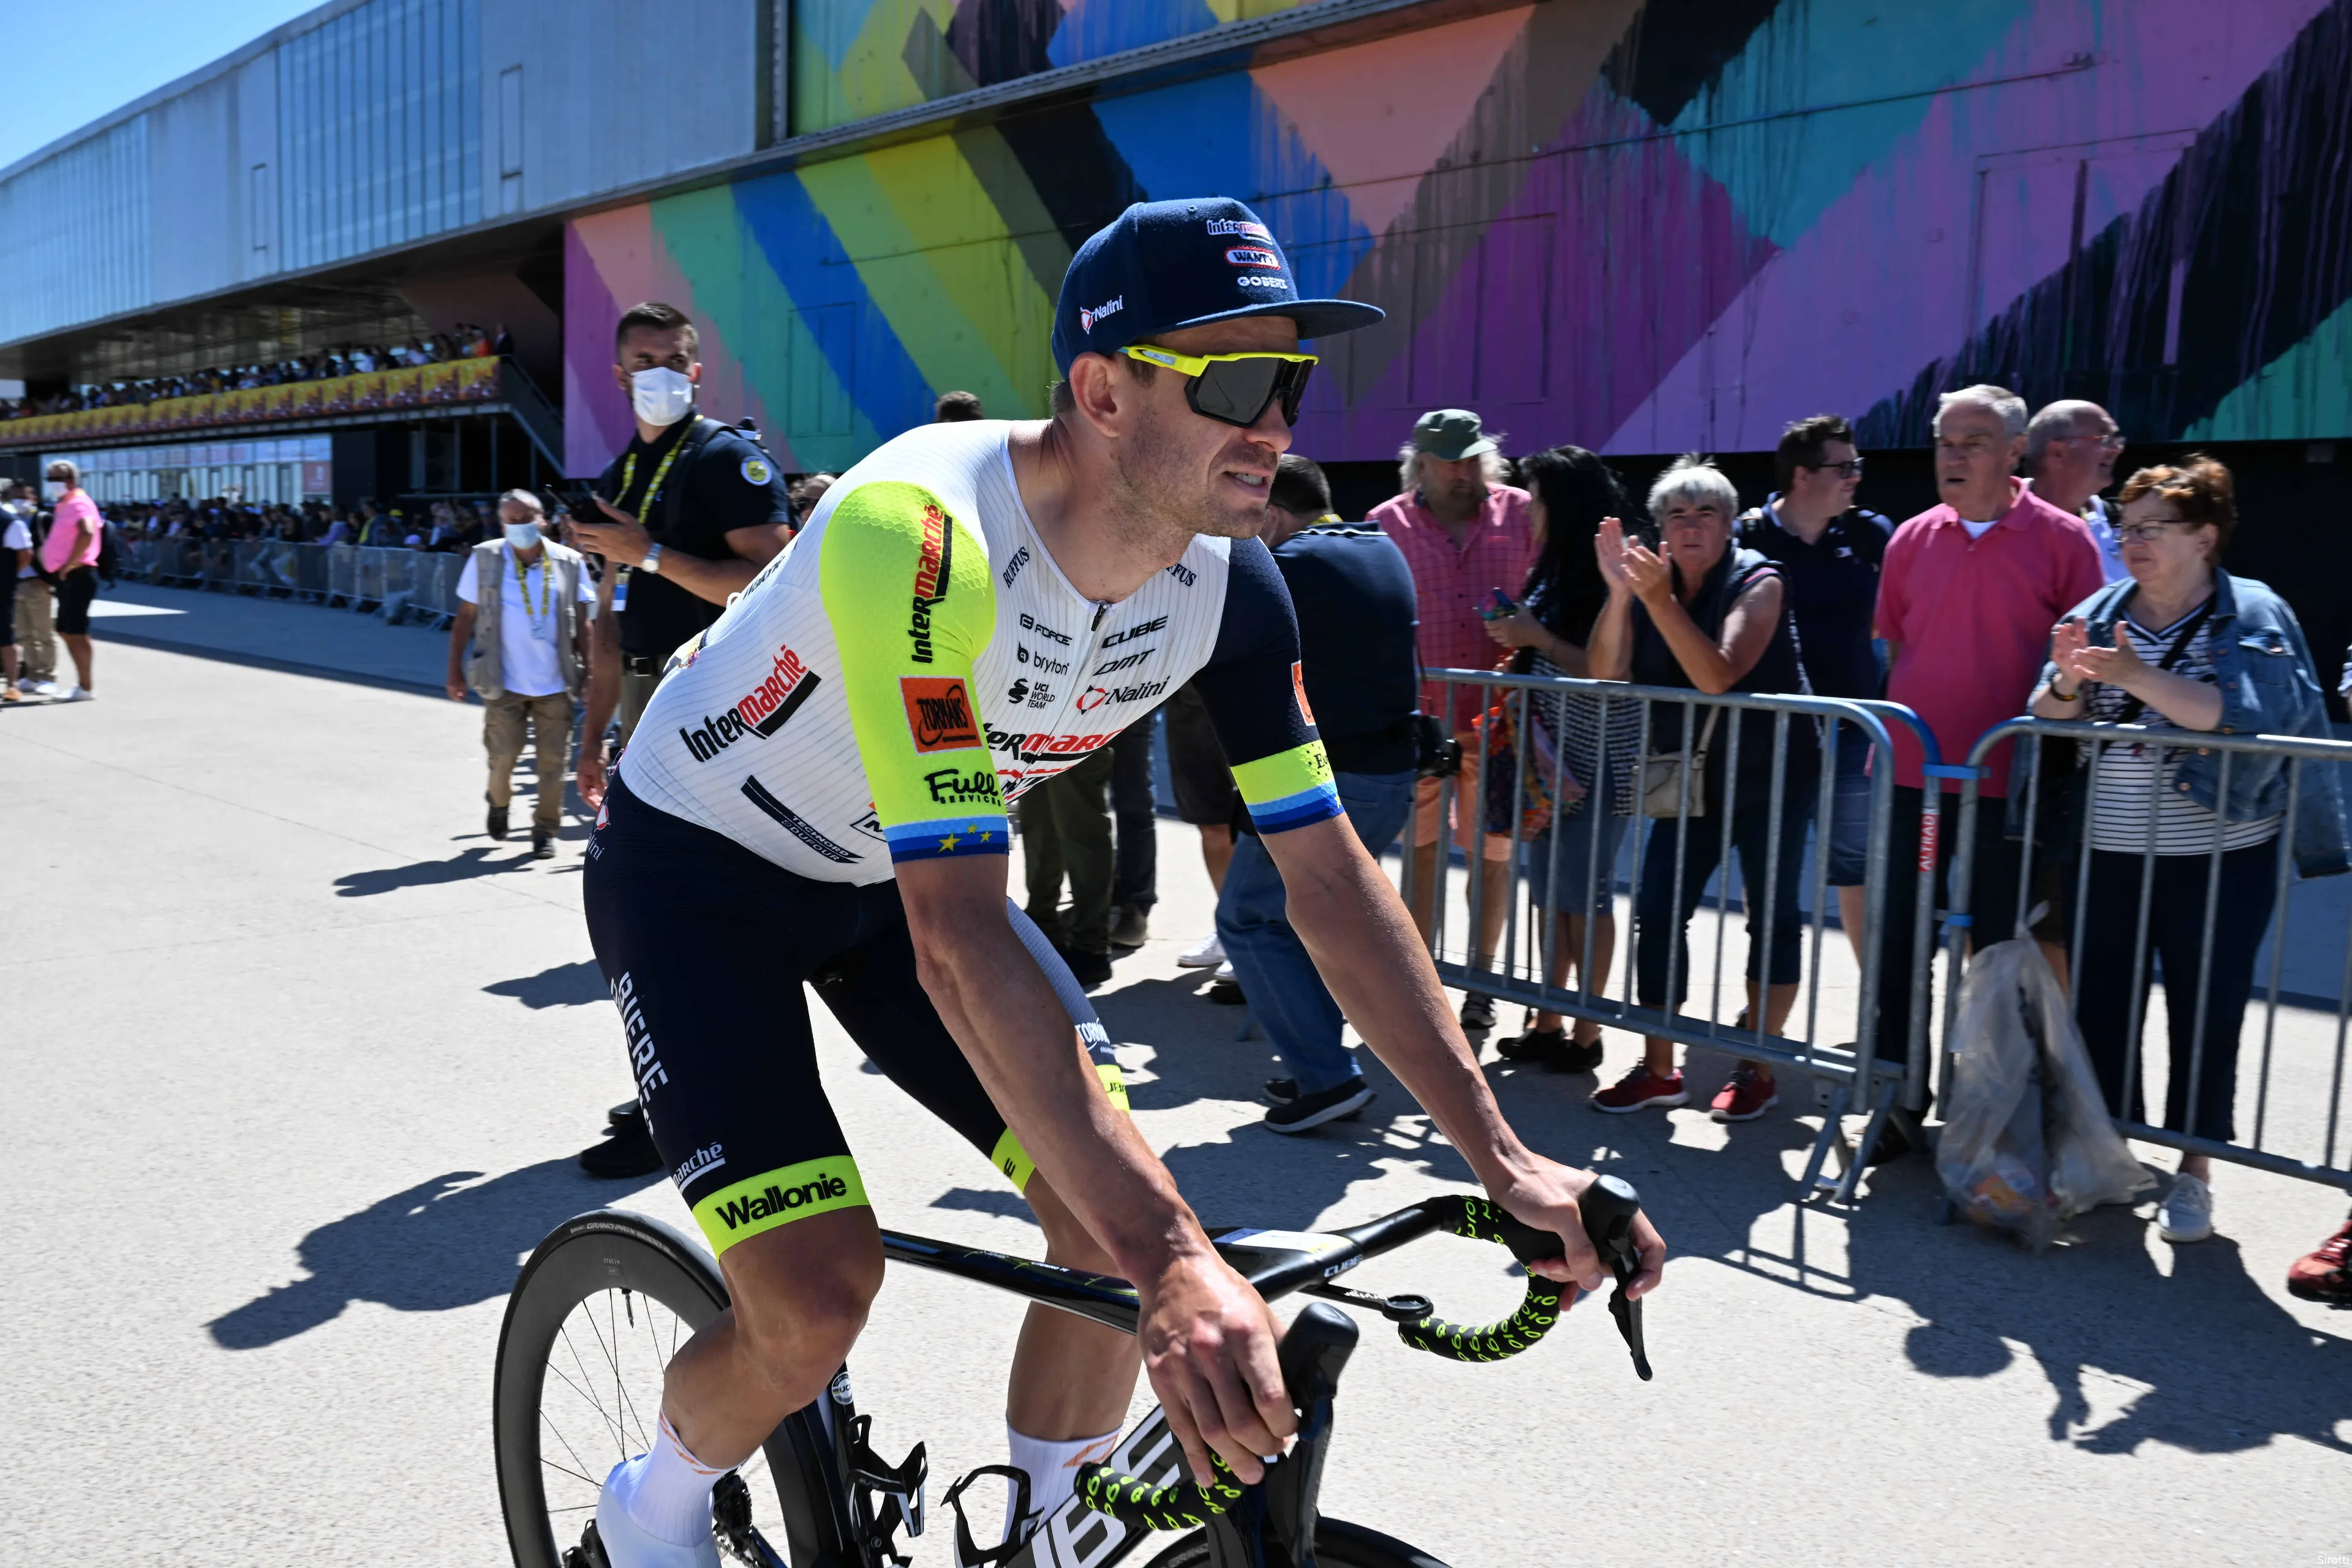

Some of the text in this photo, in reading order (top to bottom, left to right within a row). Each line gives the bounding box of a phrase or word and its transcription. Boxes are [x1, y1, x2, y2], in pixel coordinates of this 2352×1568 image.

[1095, 295, 1123, 322] Nalini
[1003, 546, 1029, 589] RUFFUS
[1035, 624, 1072, 646] FORCE
[1102, 615, 1168, 649] CUBE
[1034, 651, 1069, 675] bryton
[1093, 648, 1156, 676] DMT
[1031, 691, 1055, 702] WORLD
[1035, 682, 1049, 692] UCI
[1104, 676, 1170, 705] Nalini
[1027, 699, 1046, 709] TEAM
[924, 769, 999, 801] Full
[940, 794, 1001, 807] SERVICES
[587, 832, 605, 861] lini
[790, 827, 840, 860] DUFOUR
[793, 815, 849, 856] TECHNORD
[715, 1173, 846, 1230] Wallonie
